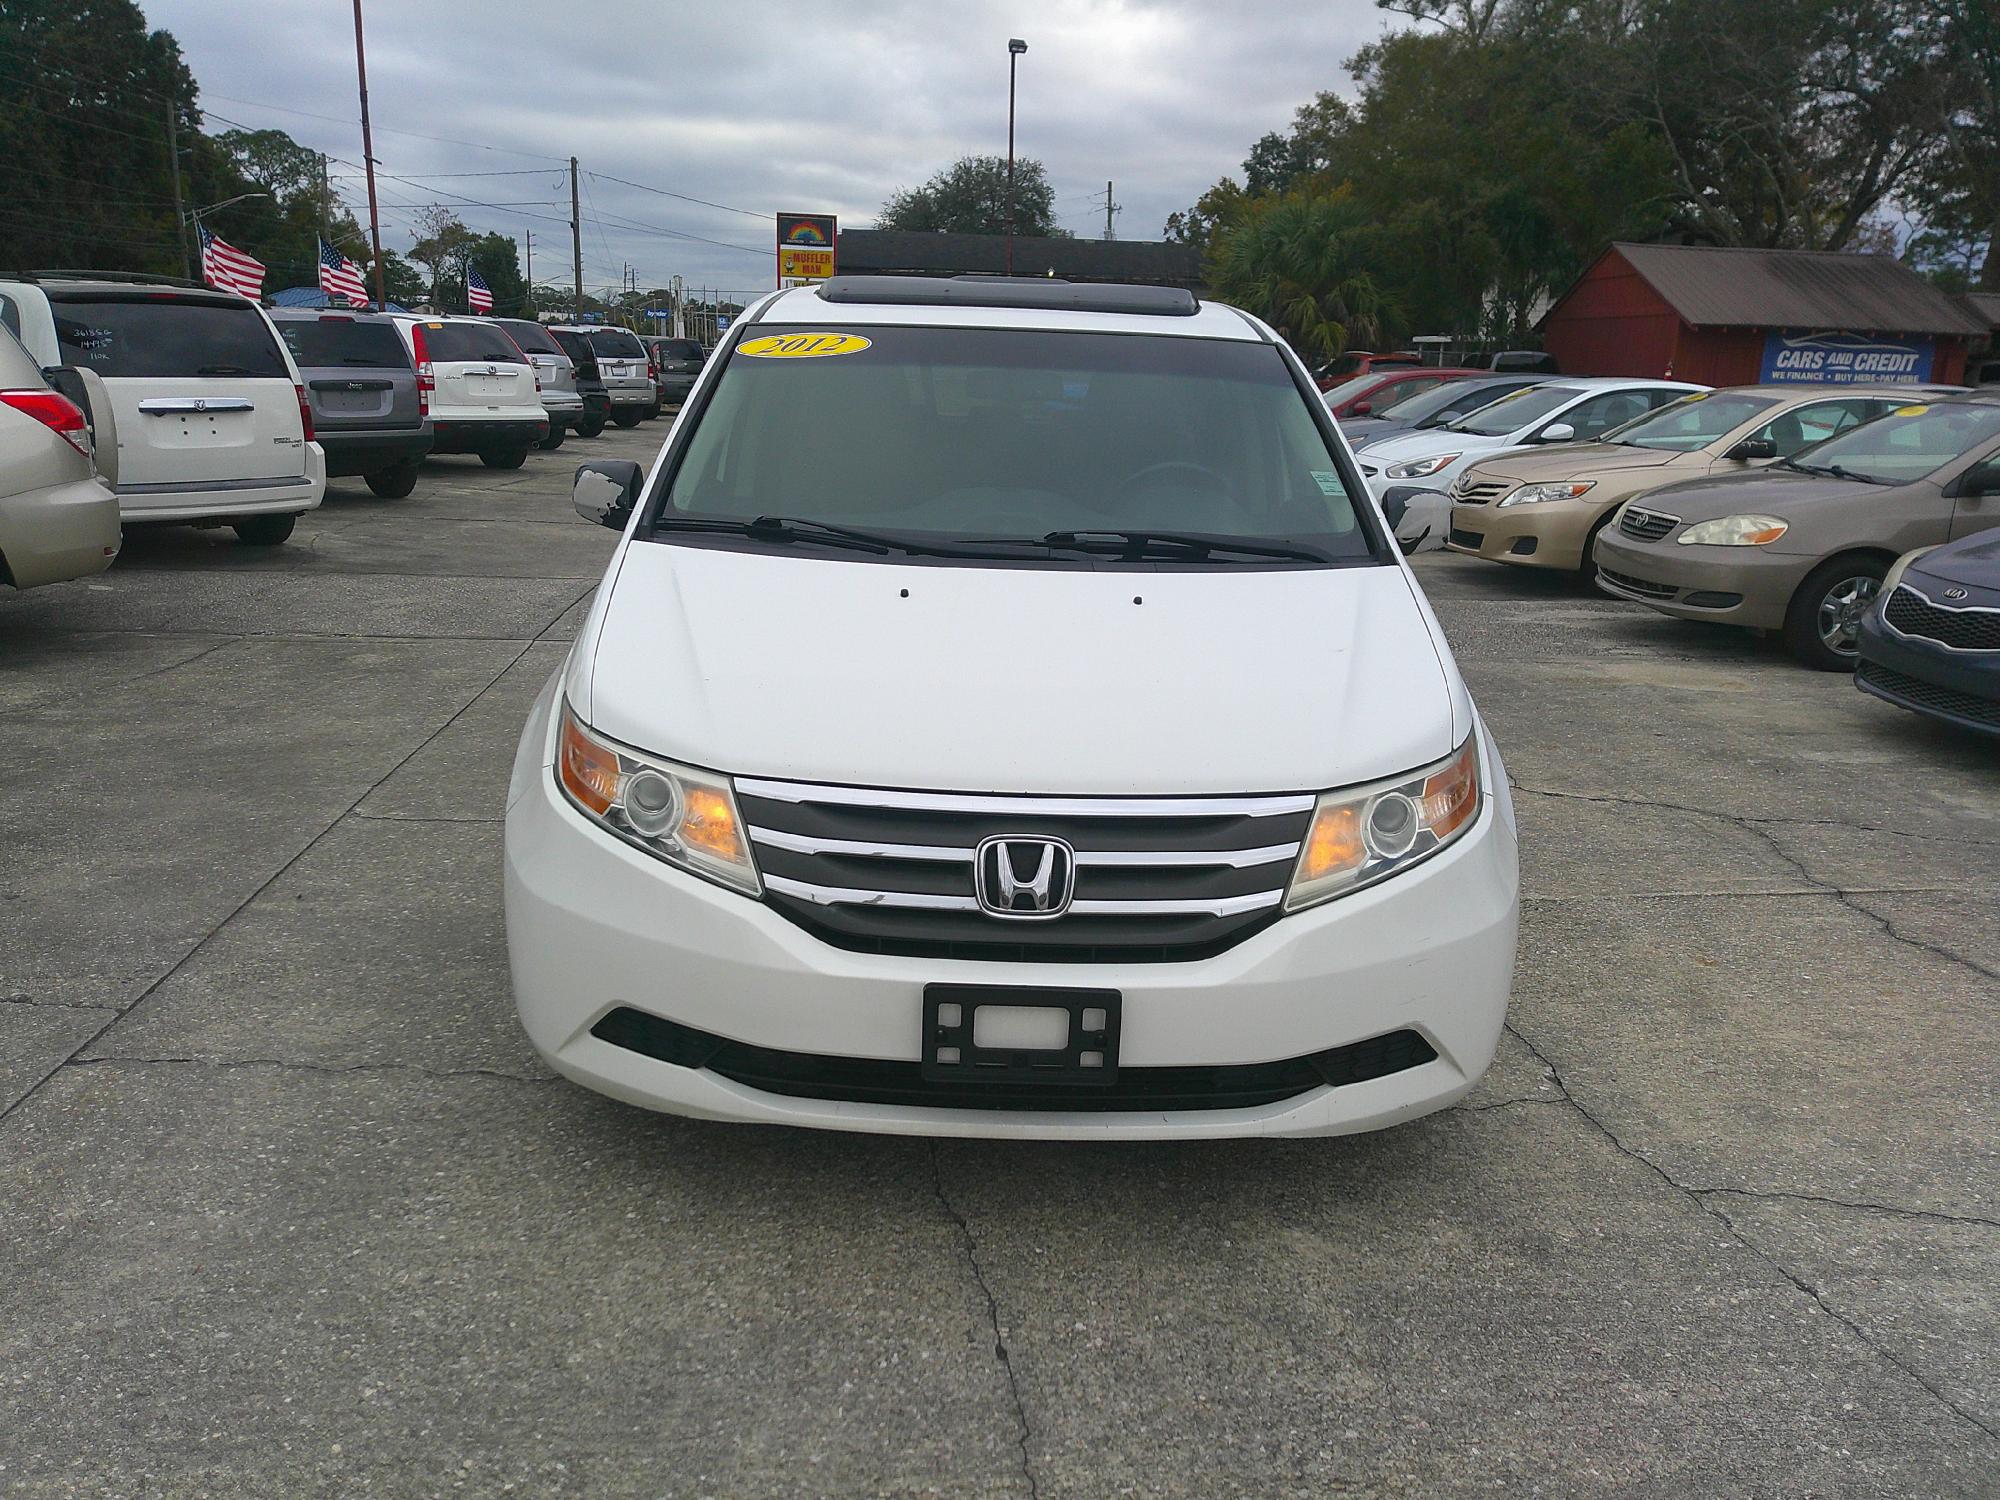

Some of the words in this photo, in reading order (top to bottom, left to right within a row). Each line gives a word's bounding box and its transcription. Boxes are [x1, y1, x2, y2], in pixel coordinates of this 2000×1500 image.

[793, 252, 831, 264] MUFFLER
[802, 264, 822, 274] MAN
[756, 336, 848, 354] 2012
[1776, 350, 1825, 369] CARS
[1827, 352, 1854, 365] AND
[1854, 353, 1919, 372] CREDIT
[1772, 371, 1786, 380] WE
[1786, 371, 1825, 381] FINANCE
[1834, 373, 1853, 382] BUY
[1897, 374, 1920, 384] HERE
